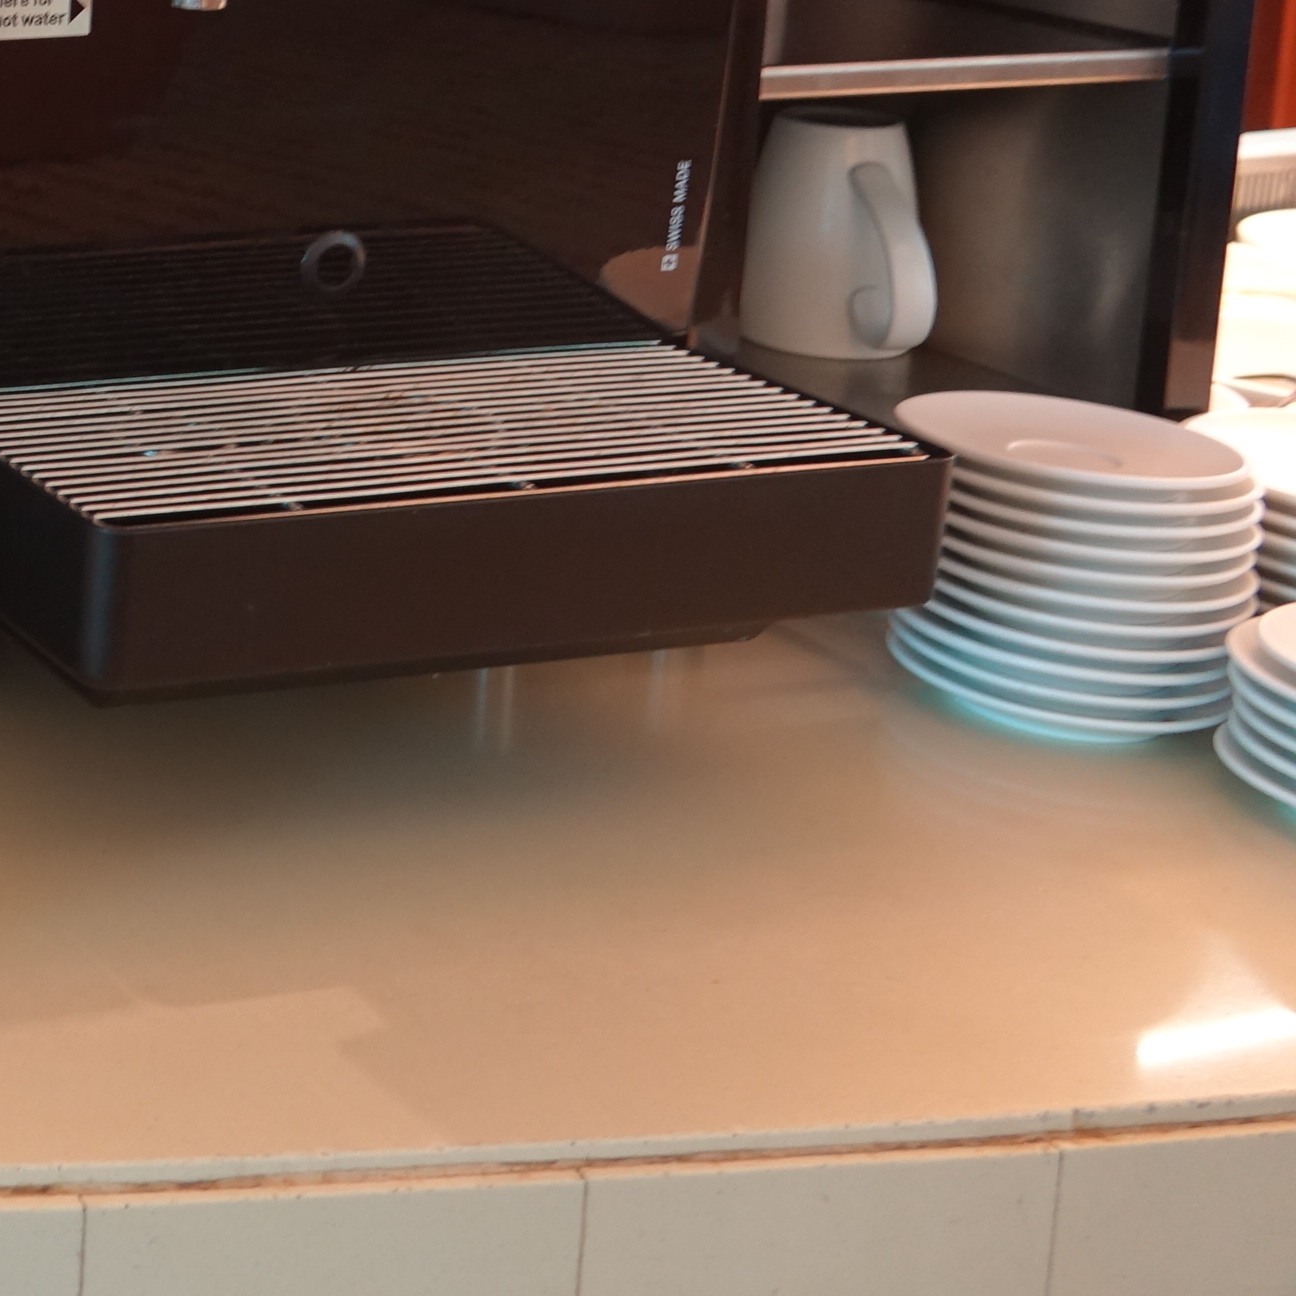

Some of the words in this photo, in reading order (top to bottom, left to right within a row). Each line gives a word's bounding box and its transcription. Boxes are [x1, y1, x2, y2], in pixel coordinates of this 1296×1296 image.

[21, 13, 68, 27] water
[672, 159, 693, 204] MADE
[665, 204, 687, 251] SWISS
